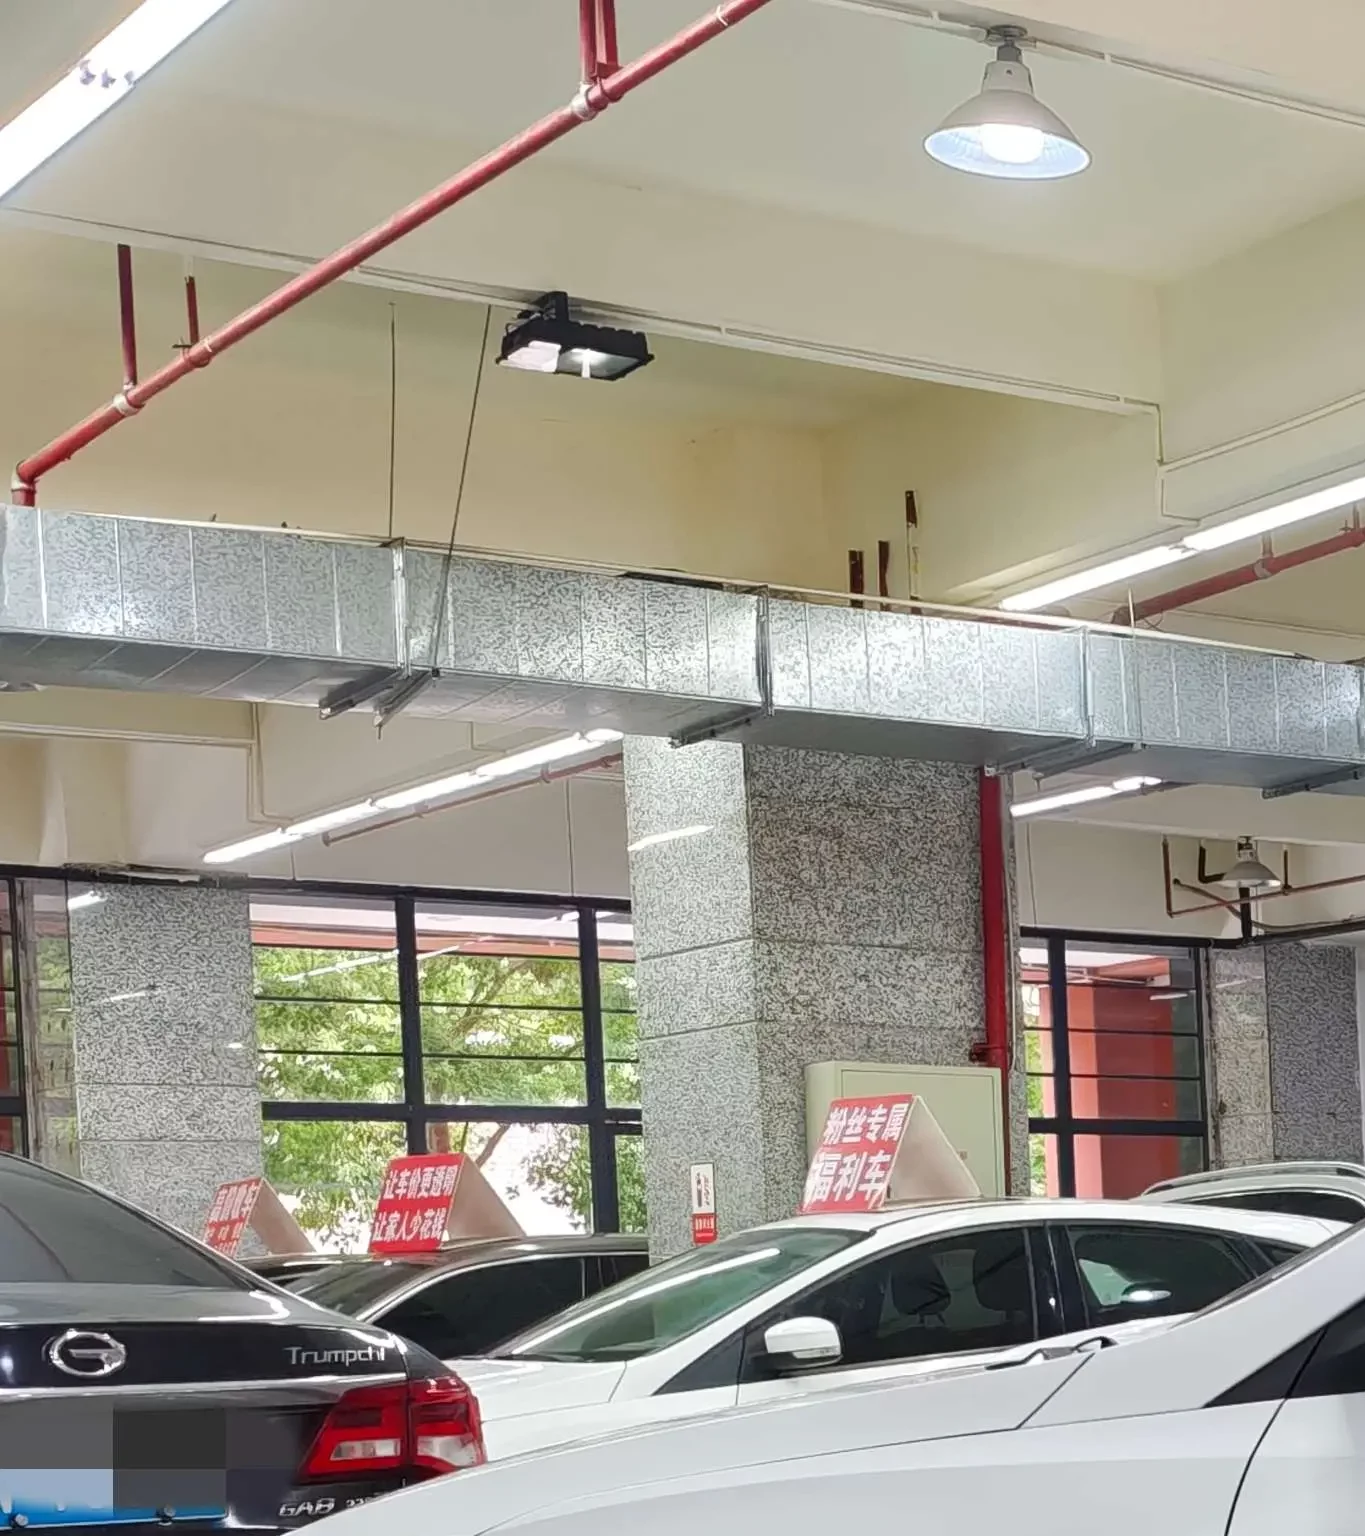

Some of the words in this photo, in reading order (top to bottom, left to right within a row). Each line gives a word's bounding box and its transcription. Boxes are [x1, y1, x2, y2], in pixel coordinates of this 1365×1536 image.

[823, 1103, 909, 1145] 粉丝专属
[383, 1164, 458, 1200] 让车价更透明
[802, 1149, 892, 1211] 福利车
[372, 1207, 446, 1242] 让家人少花钱
[284, 1346, 385, 1366] Trumpchi
